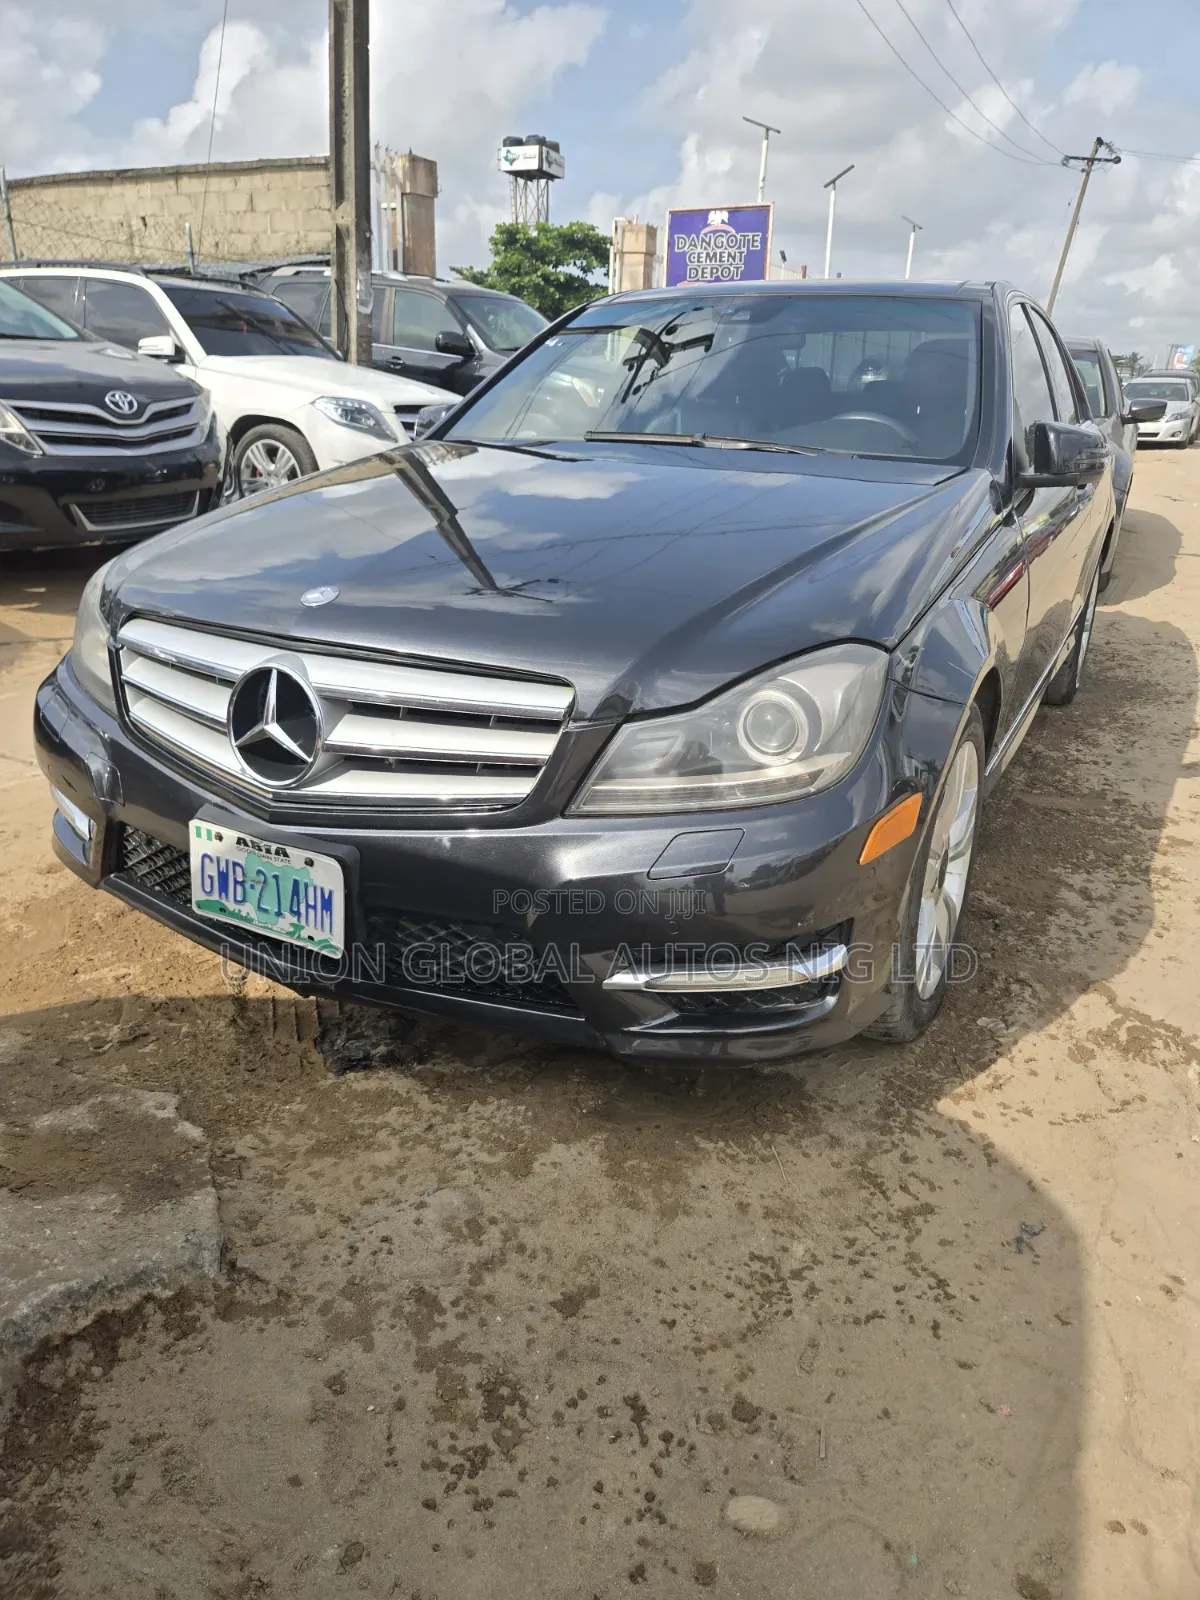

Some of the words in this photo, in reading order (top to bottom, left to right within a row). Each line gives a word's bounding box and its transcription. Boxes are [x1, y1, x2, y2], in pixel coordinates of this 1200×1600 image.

[674, 233, 762, 252] DANGOTE
[686, 250, 747, 265] CEMENT
[687, 265, 745, 281] DEPOT
[236, 836, 291, 858] ABIA
[273, 856, 292, 865] STATE
